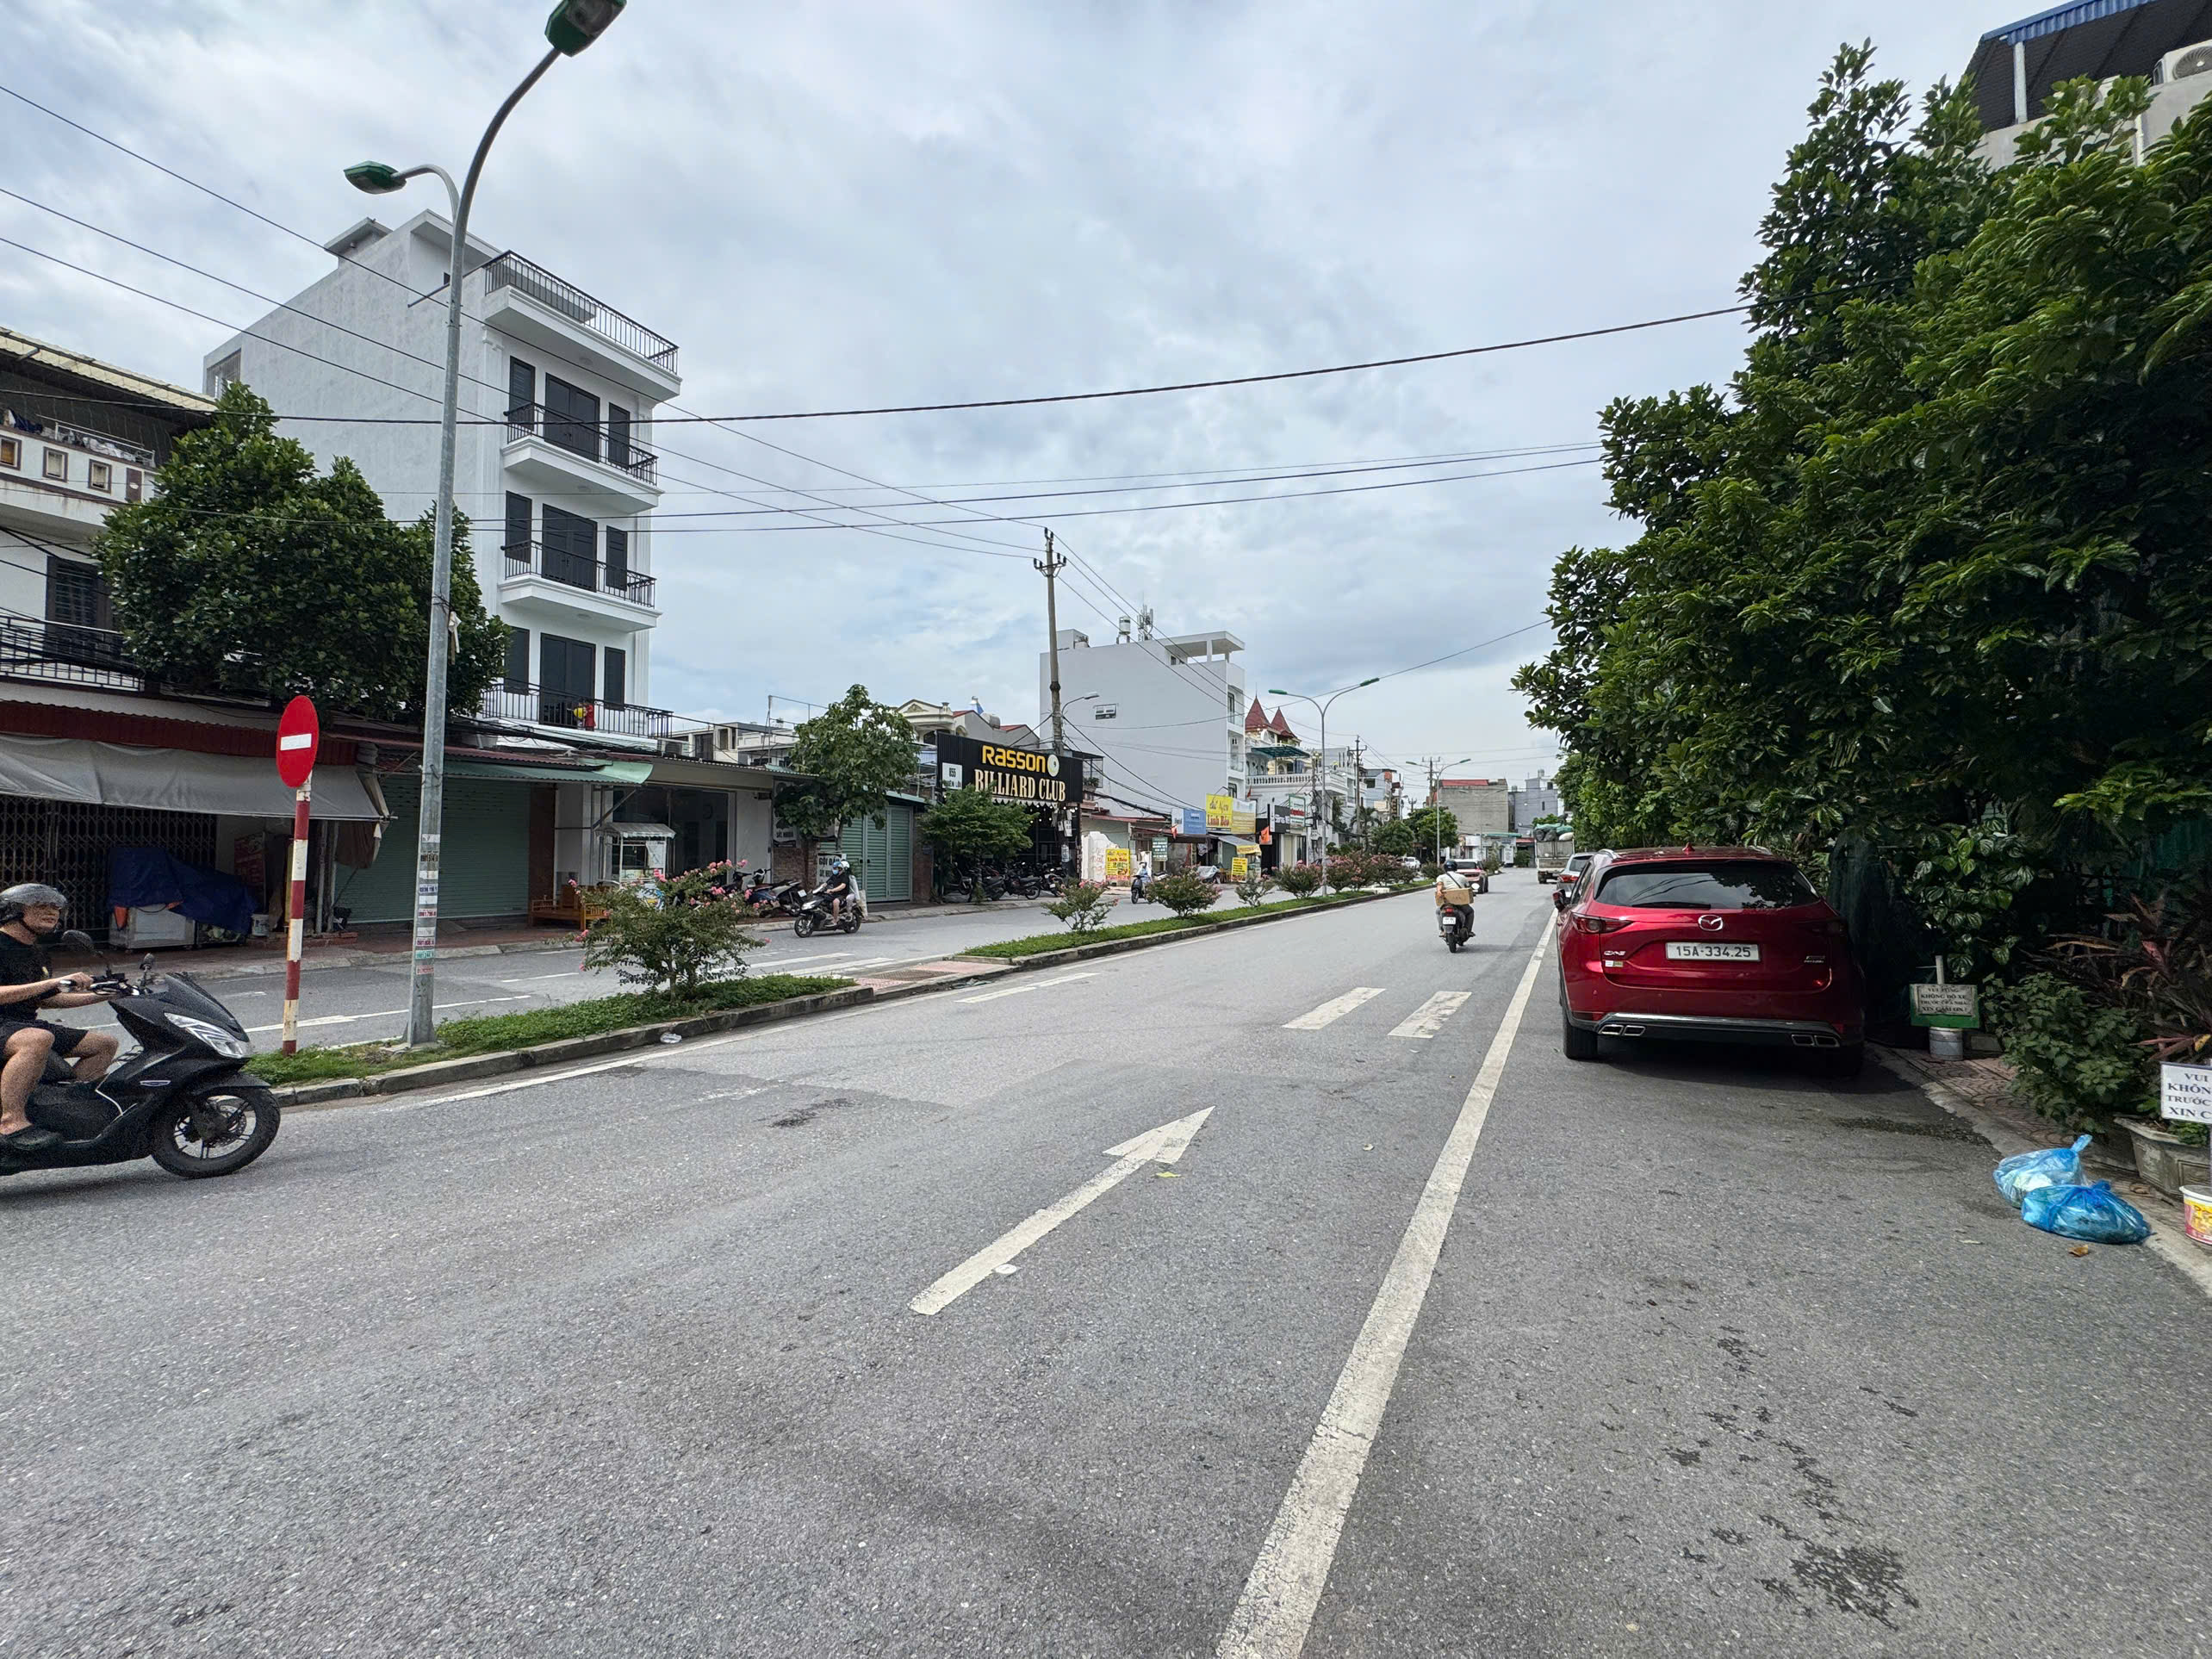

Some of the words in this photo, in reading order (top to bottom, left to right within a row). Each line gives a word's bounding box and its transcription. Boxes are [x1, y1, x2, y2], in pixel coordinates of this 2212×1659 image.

[974, 768, 1035, 798] BILLIARD
[1039, 778, 1066, 802] CLUB
[1676, 946, 1751, 958] 15A-334.25
[2184, 1073, 2209, 1083] VUI
[2167, 1083, 2212, 1095] KHÔN
[2165, 1095, 2212, 1107] TRƯỚC
[2169, 1106, 2196, 1117] XIN
